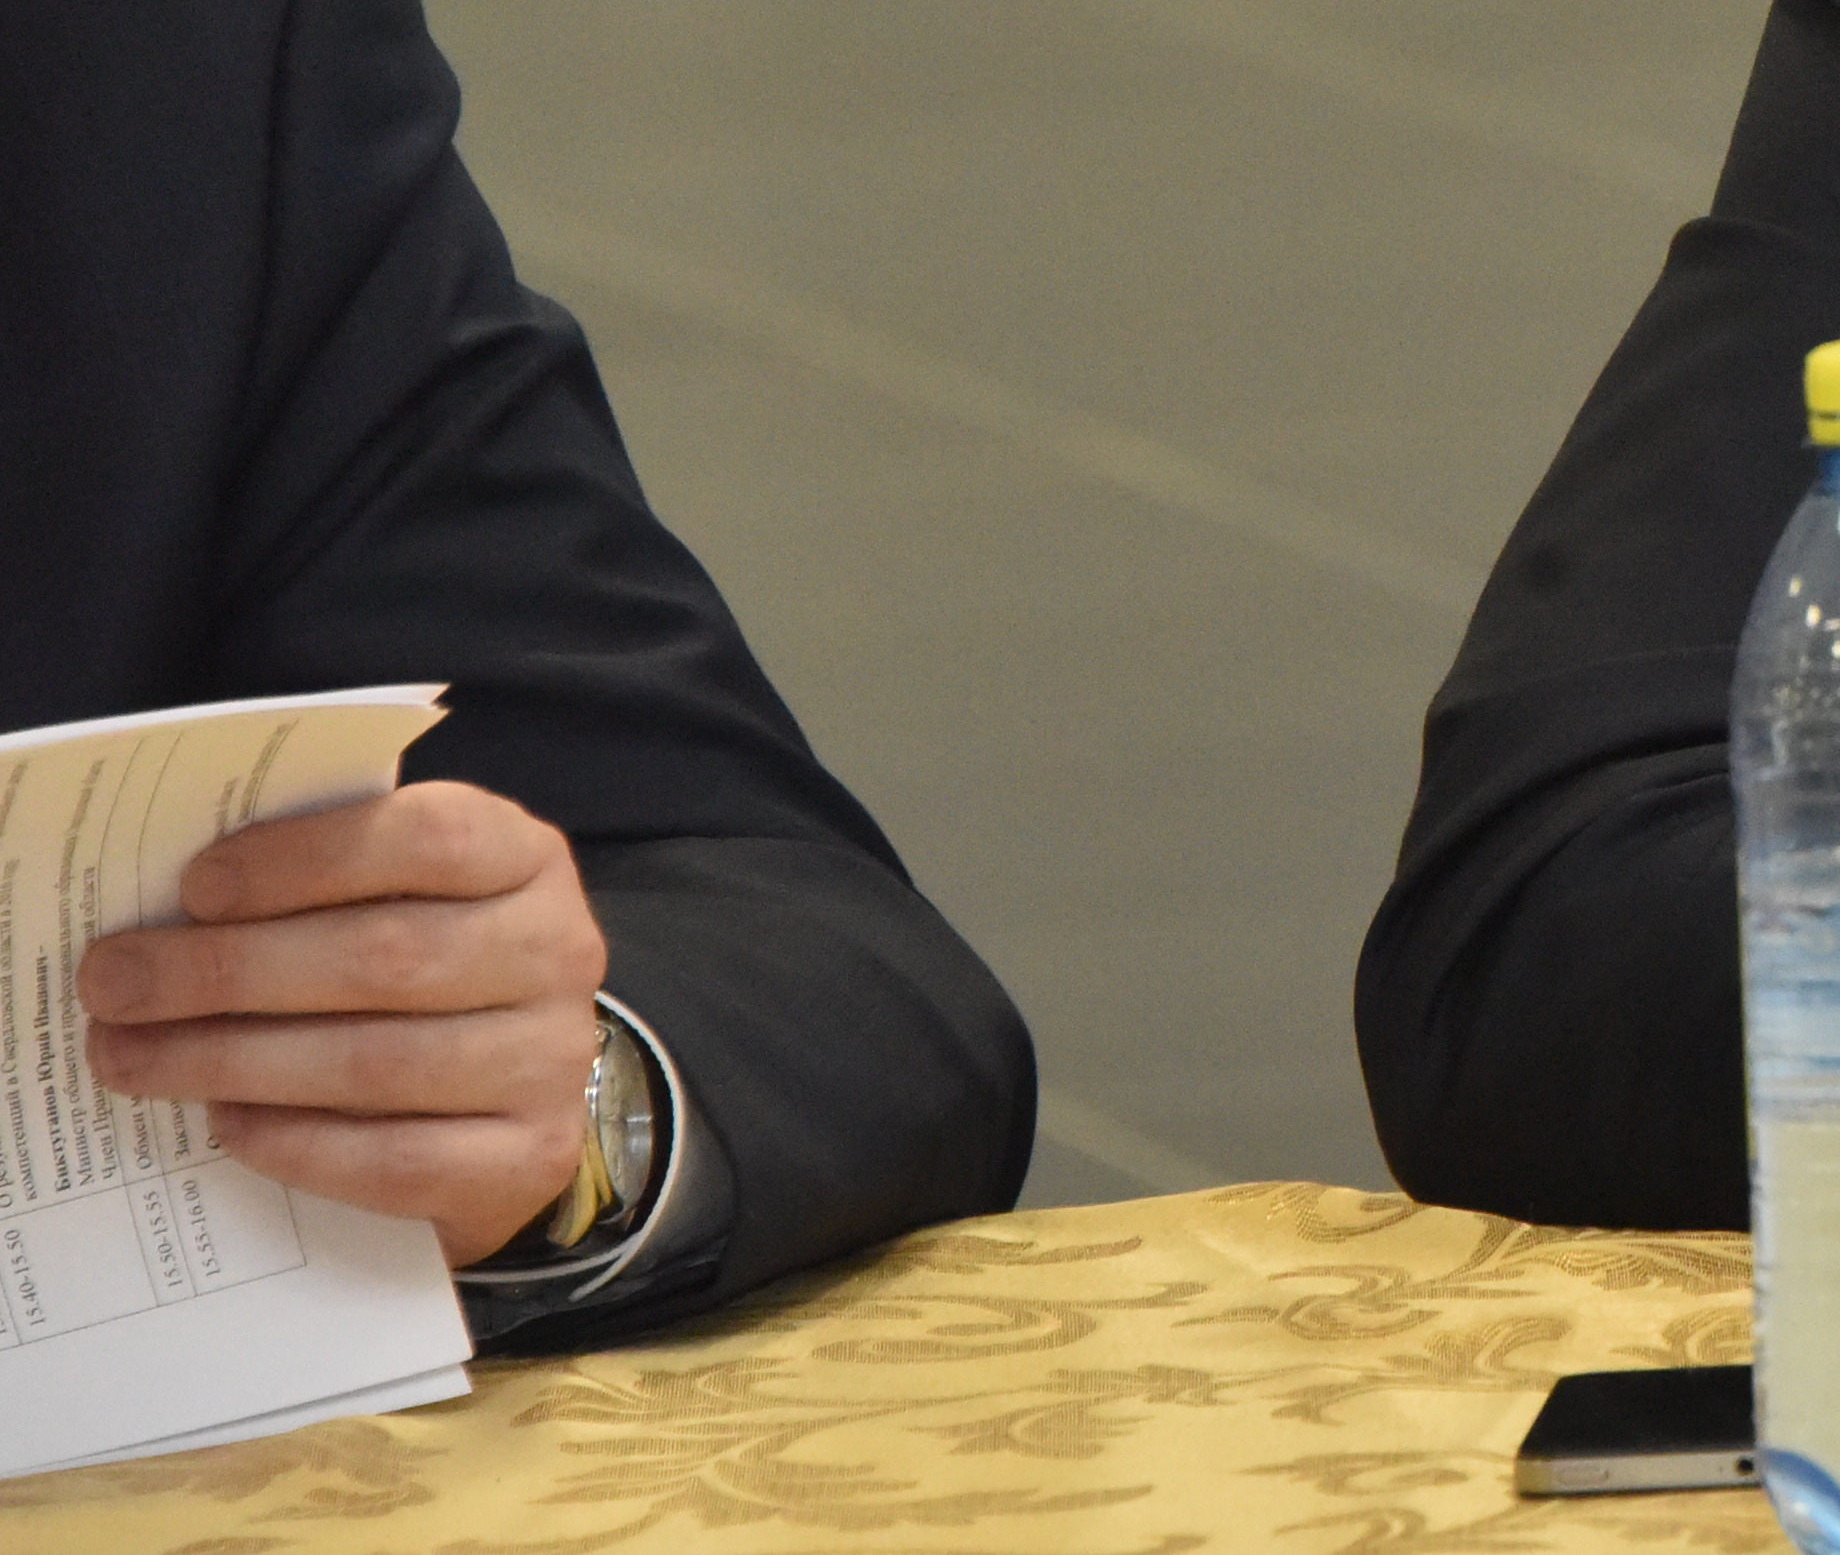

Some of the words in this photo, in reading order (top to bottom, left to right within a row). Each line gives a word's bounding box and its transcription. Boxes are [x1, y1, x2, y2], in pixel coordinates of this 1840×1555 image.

[35, 1031, 55, 1082] Юрий
[5, 1090, 38, 1202] компетенций
[42, 1086, 71, 1194] Биктуганов
[69, 1108, 95, 1186] Министр
[100, 1135, 117, 1180] Член
[132, 1112, 152, 1170] Обмен
[143, 1190, 182, 1286] 15.50-15.55
[181, 1180, 220, 1276] 15.55-16.00
[4, 1230, 46, 1326] 15.40-15.50
